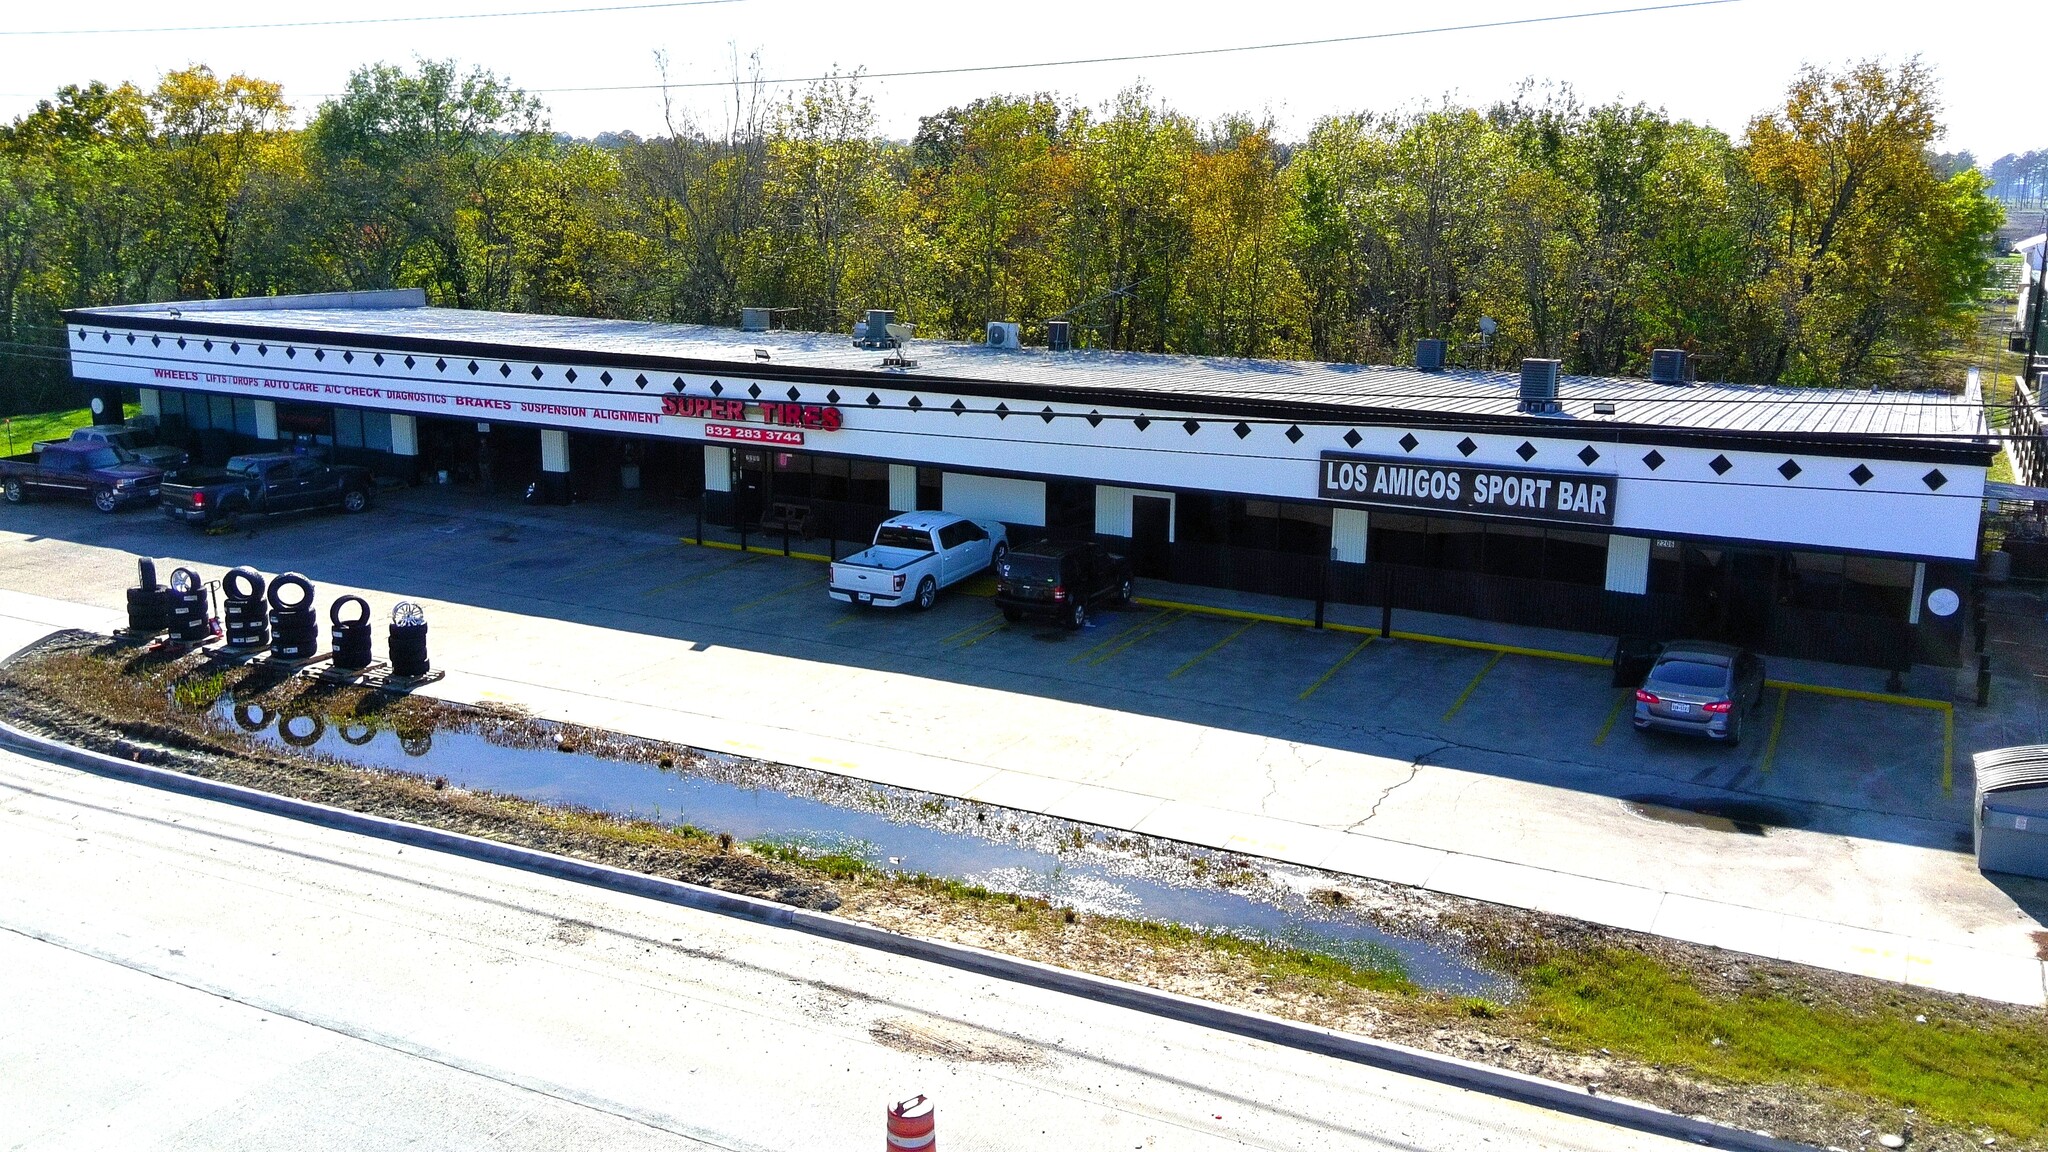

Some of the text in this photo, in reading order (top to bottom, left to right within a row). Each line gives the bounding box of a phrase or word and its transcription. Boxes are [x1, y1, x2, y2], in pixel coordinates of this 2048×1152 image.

[154, 369, 198, 380] WHEELS
[264, 379, 290, 389] AUTO
[292, 381, 319, 392] CARE
[324, 384, 341, 394] A/C
[344, 386, 381, 398] CHECK
[386, 390, 447, 404] DIAGNOSTICS
[455, 395, 511, 410] BRAKES
[521, 402, 586, 417] SUSPENSION
[593, 409, 661, 424] ALIGNMENT
[661, 392, 843, 432] SUPER TIRES
[705, 425, 802, 443] 832 283 3744
[1326, 461, 1607, 514] LOS AMIGOS SPORT BAR
